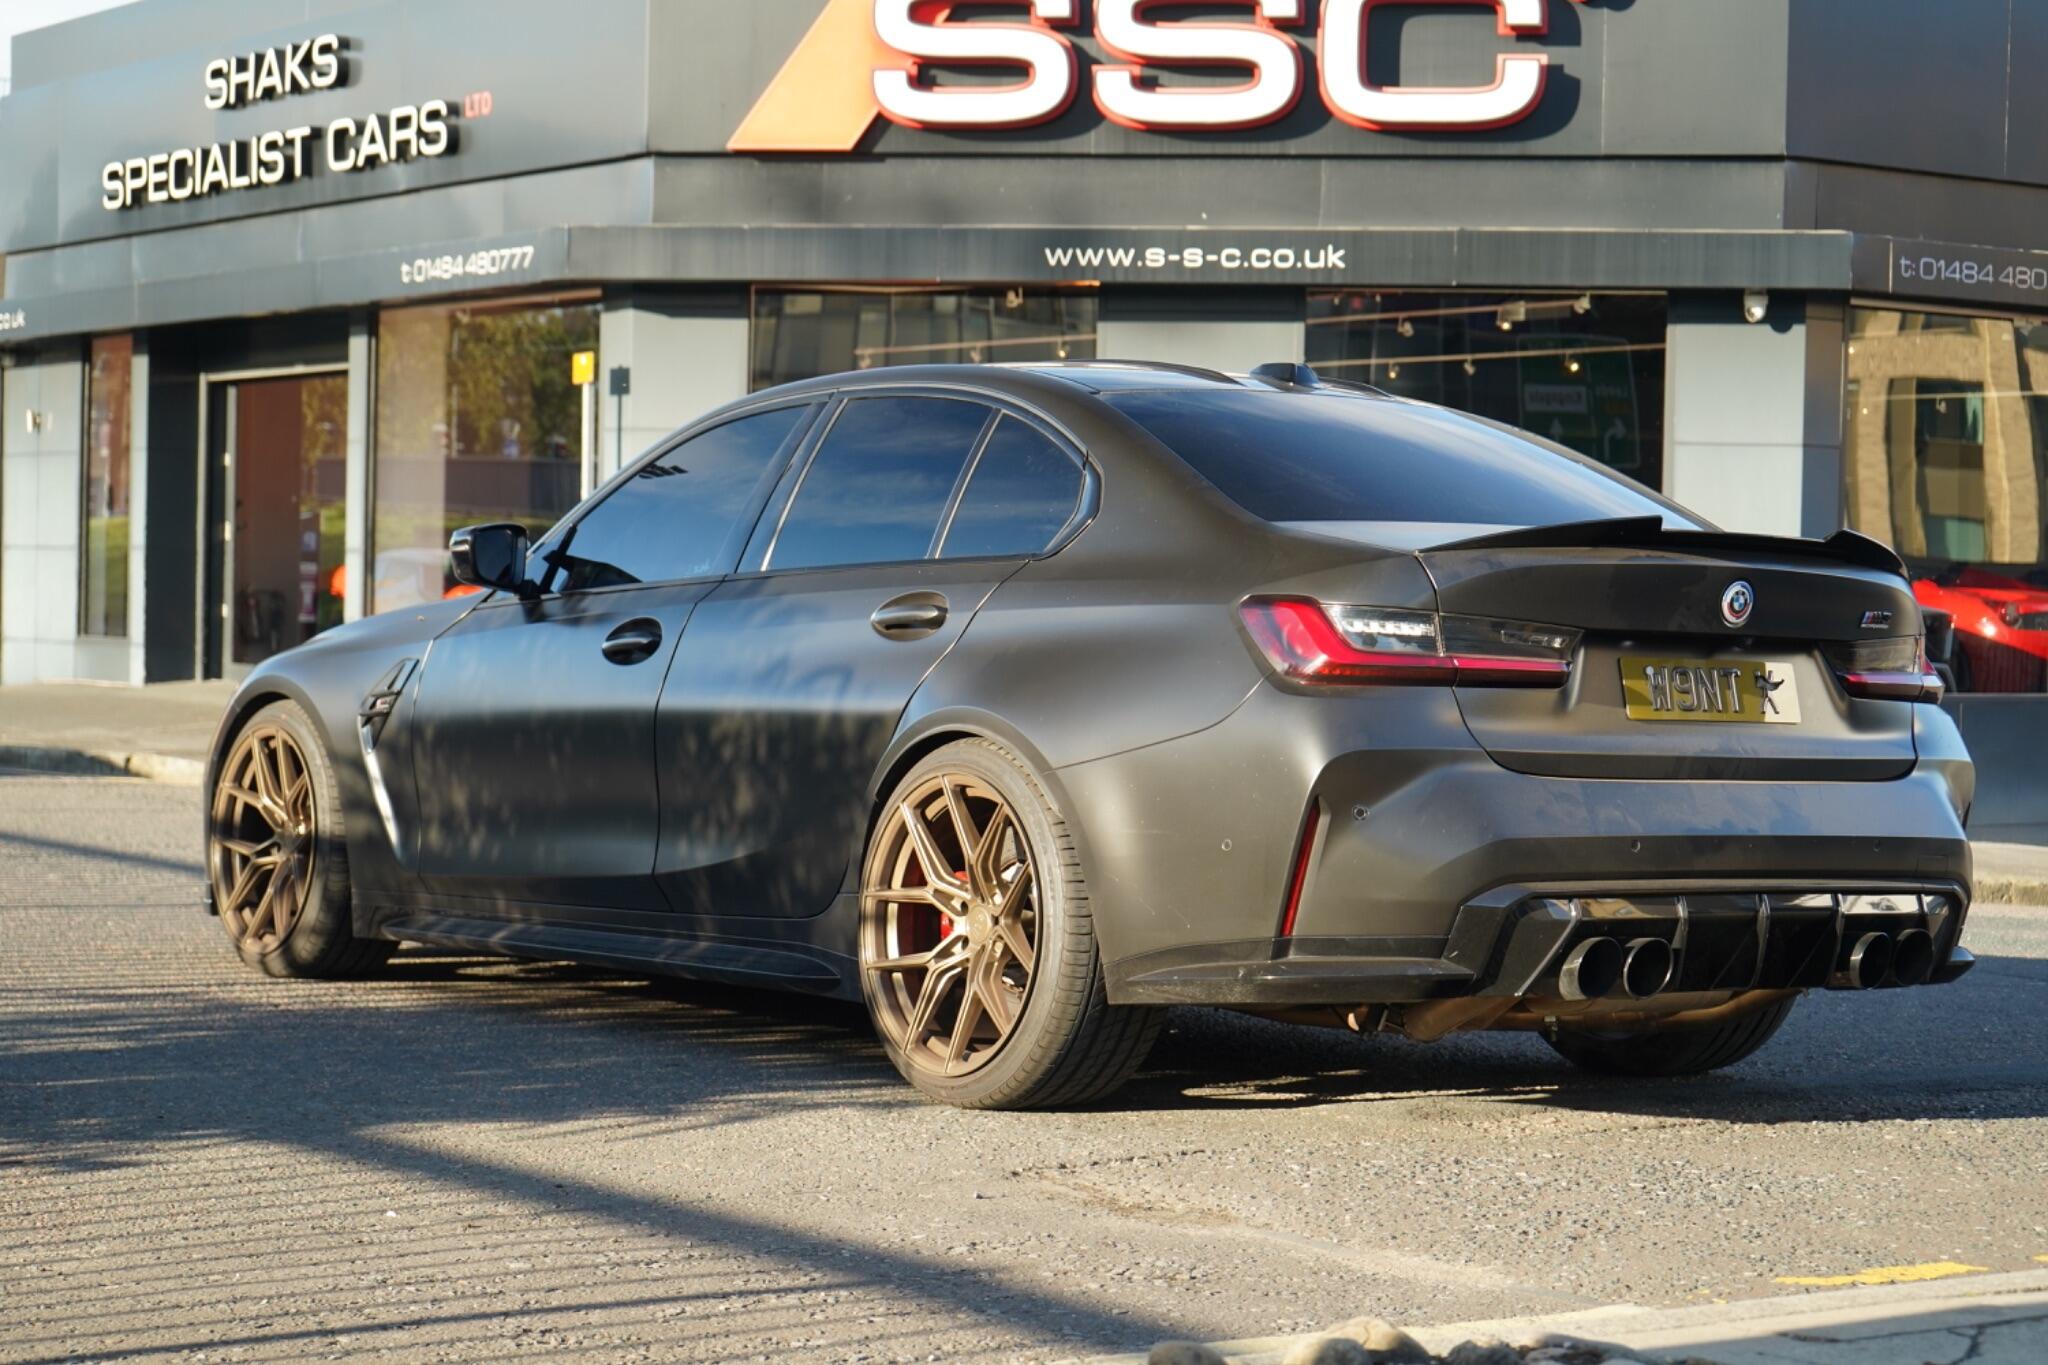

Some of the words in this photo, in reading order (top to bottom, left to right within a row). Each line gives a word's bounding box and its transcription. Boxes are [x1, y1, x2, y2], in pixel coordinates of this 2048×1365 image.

[204, 33, 339, 110] SHAKS
[871, 0, 1547, 130] SSC
[102, 126, 311, 210] SPECIALIST
[326, 99, 449, 172] CARS
[464, 91, 493, 119] LTD
[1044, 244, 1346, 268] www.s-s-c.co.uk
[1998, 265, 2048, 290] 480
